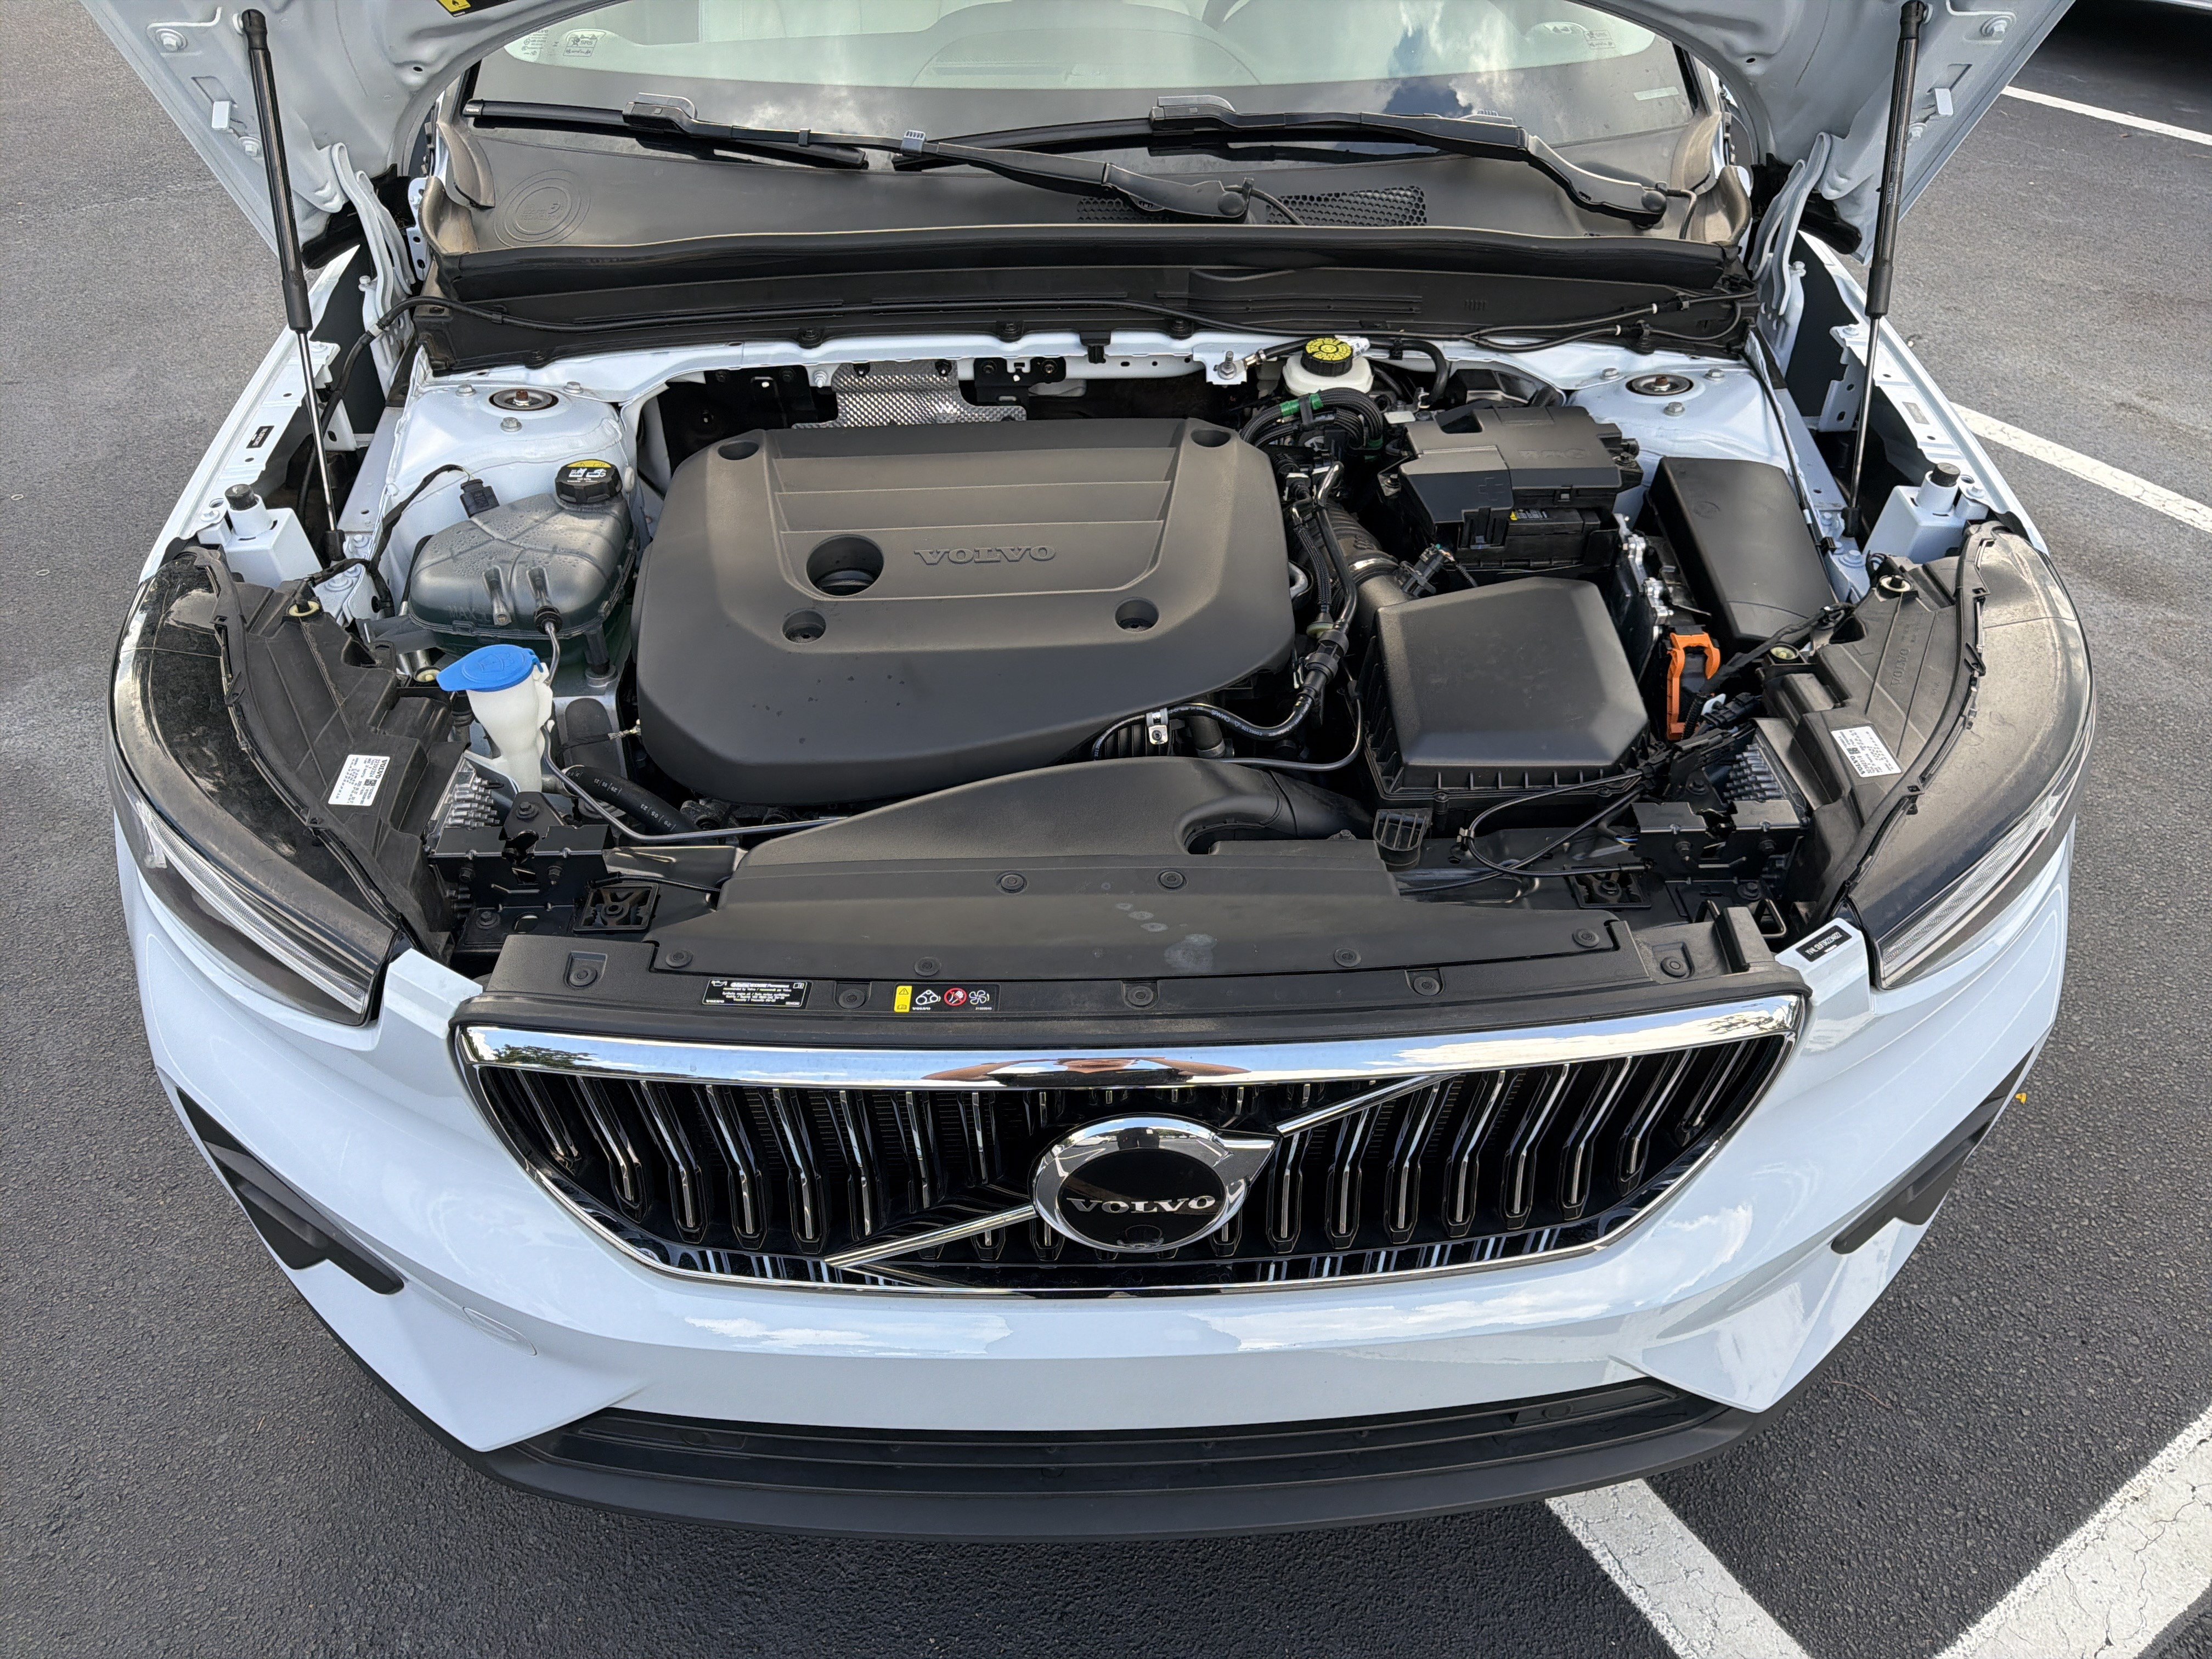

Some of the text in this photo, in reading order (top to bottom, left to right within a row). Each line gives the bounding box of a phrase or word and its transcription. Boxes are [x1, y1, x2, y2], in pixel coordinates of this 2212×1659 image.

[915, 544, 1057, 565] VOLVO
[1890, 648, 1910, 687] VOLVO
[375, 759, 388, 779] VOLVO
[1850, 755, 1866, 775] VOLVO
[1066, 1195, 1216, 1214] VOLVO
